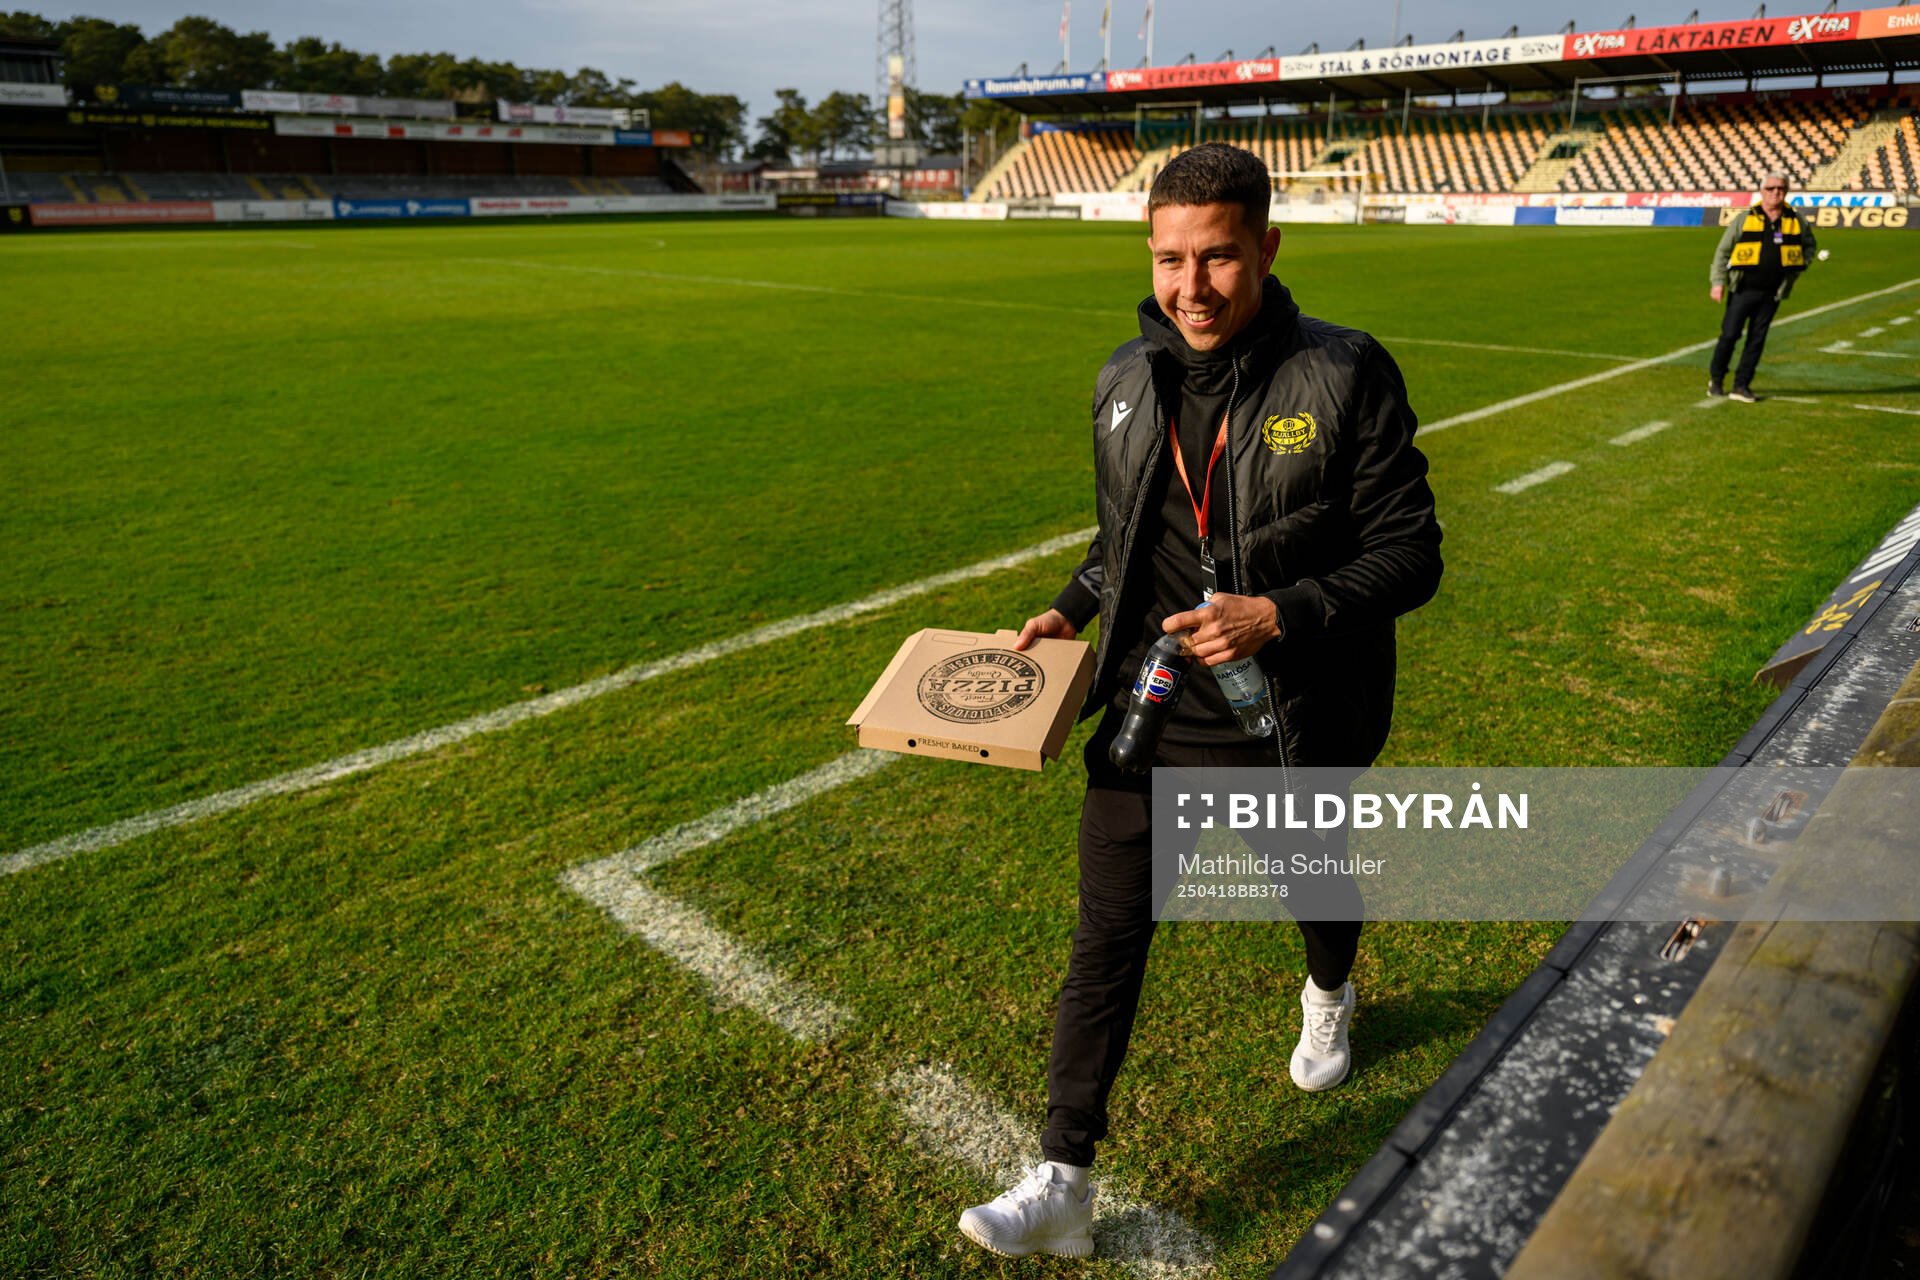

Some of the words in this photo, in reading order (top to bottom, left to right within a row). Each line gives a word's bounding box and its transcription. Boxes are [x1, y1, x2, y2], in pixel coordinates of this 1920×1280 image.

[1887, 13, 1920, 28] Enkl
[1636, 25, 1775, 52] LÄKTAREN
[1320, 53, 1353, 74] STÅL
[1361, 58, 1371, 71] &
[1379, 46, 1511, 71] RÖRMONTAGE
[947, 654, 987, 672] FRESH
[992, 654, 1027, 672] MADE
[928, 678, 1036, 693] PIZZA
[939, 703, 1012, 719] DELICIOUS
[918, 737, 950, 749] FRESHLY
[952, 742, 980, 753] BAKED
